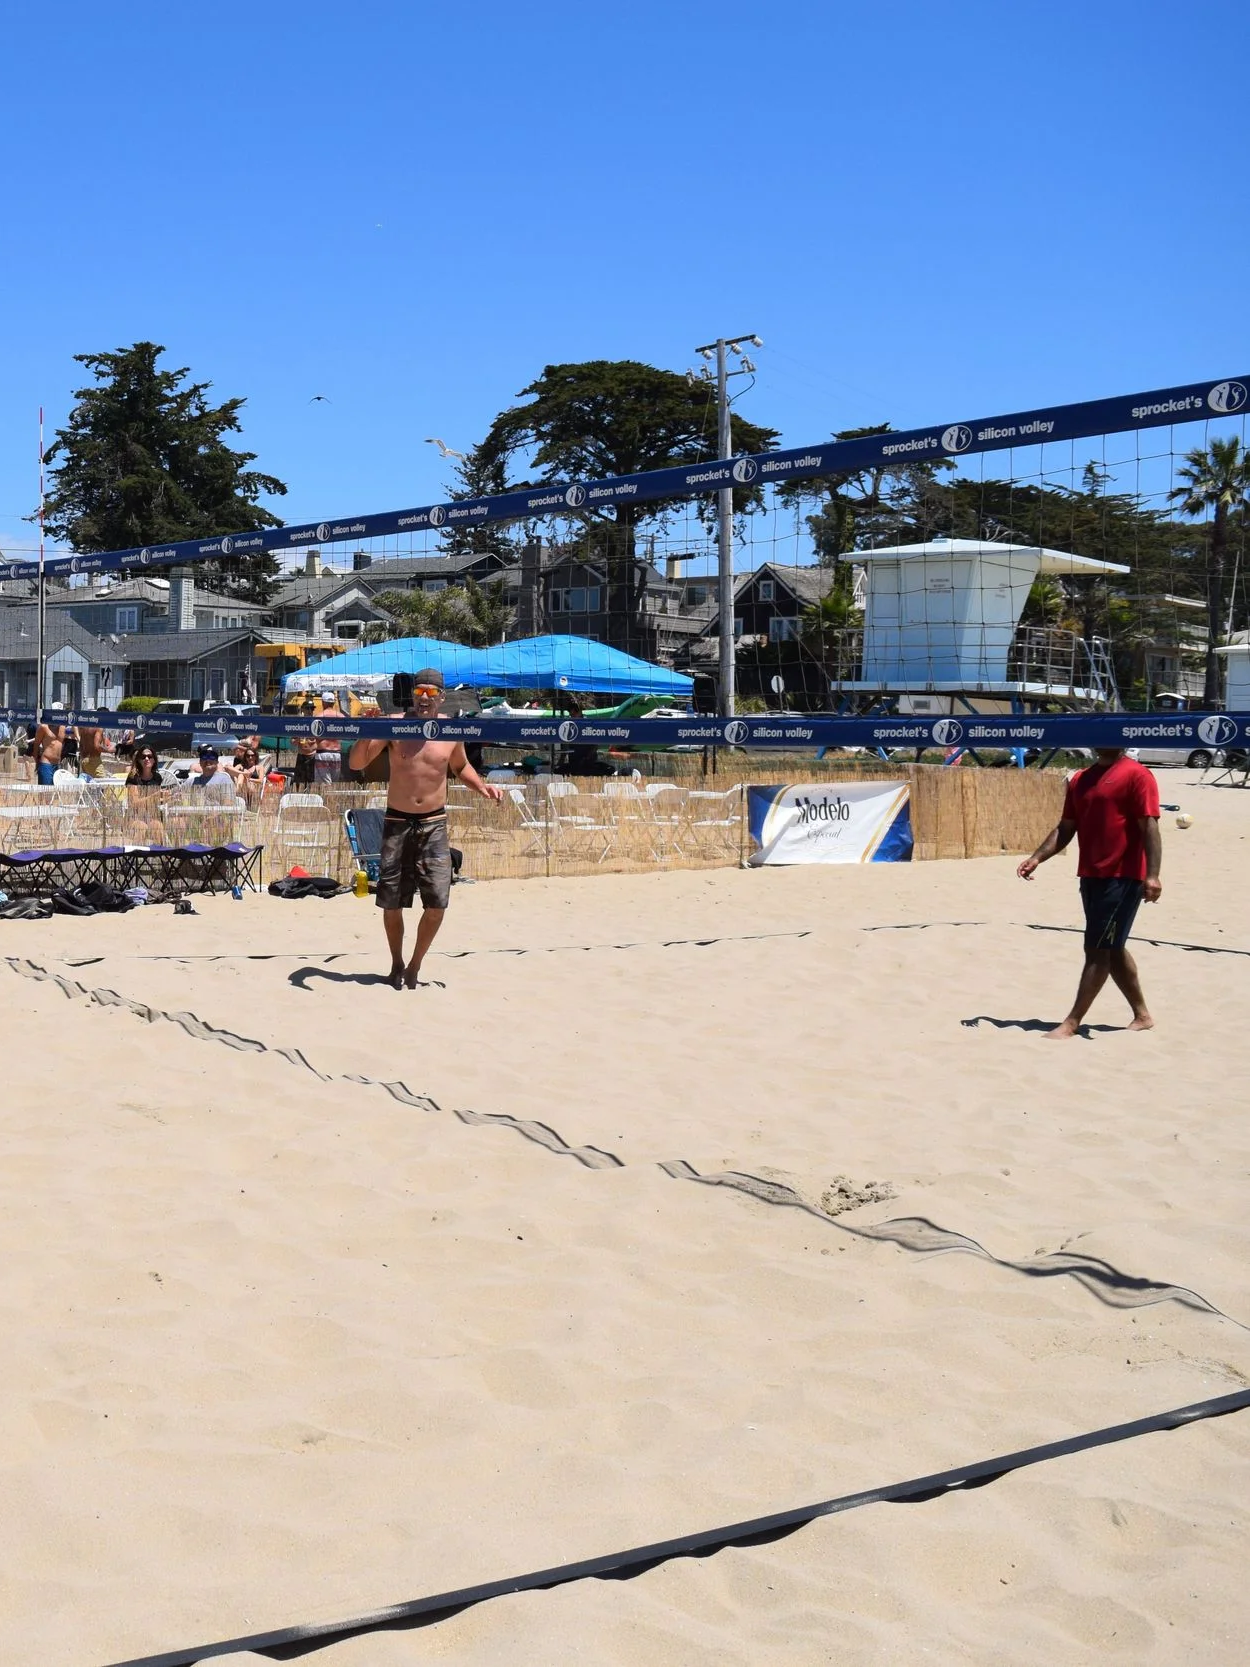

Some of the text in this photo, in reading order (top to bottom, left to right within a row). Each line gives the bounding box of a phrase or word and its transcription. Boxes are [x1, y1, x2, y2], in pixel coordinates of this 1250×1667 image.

[1132, 396, 1204, 420] sprocket's
[882, 420, 1055, 457] sprocket's silicon volley
[686, 455, 822, 486] sprocket's silicon volley
[528, 483, 638, 509] sprocket's silicon volley
[398, 505, 489, 527] sprocket's silicon volley
[290, 523, 366, 542] sprocket's silicon volley
[199, 537, 264, 554] sprocket's silicon volley
[285, 723, 361, 734] sprocket's silicon volley
[392, 724, 482, 737] sprocket's silicon volley
[521, 726, 631, 739] sprocket's silicon volley
[678, 726, 814, 740] sprocket's silicon volley
[874, 725, 1045, 740] sprocket's silicon volley
[1122, 723, 1193, 739] sprocket's
[795, 796, 851, 824] Modelo
